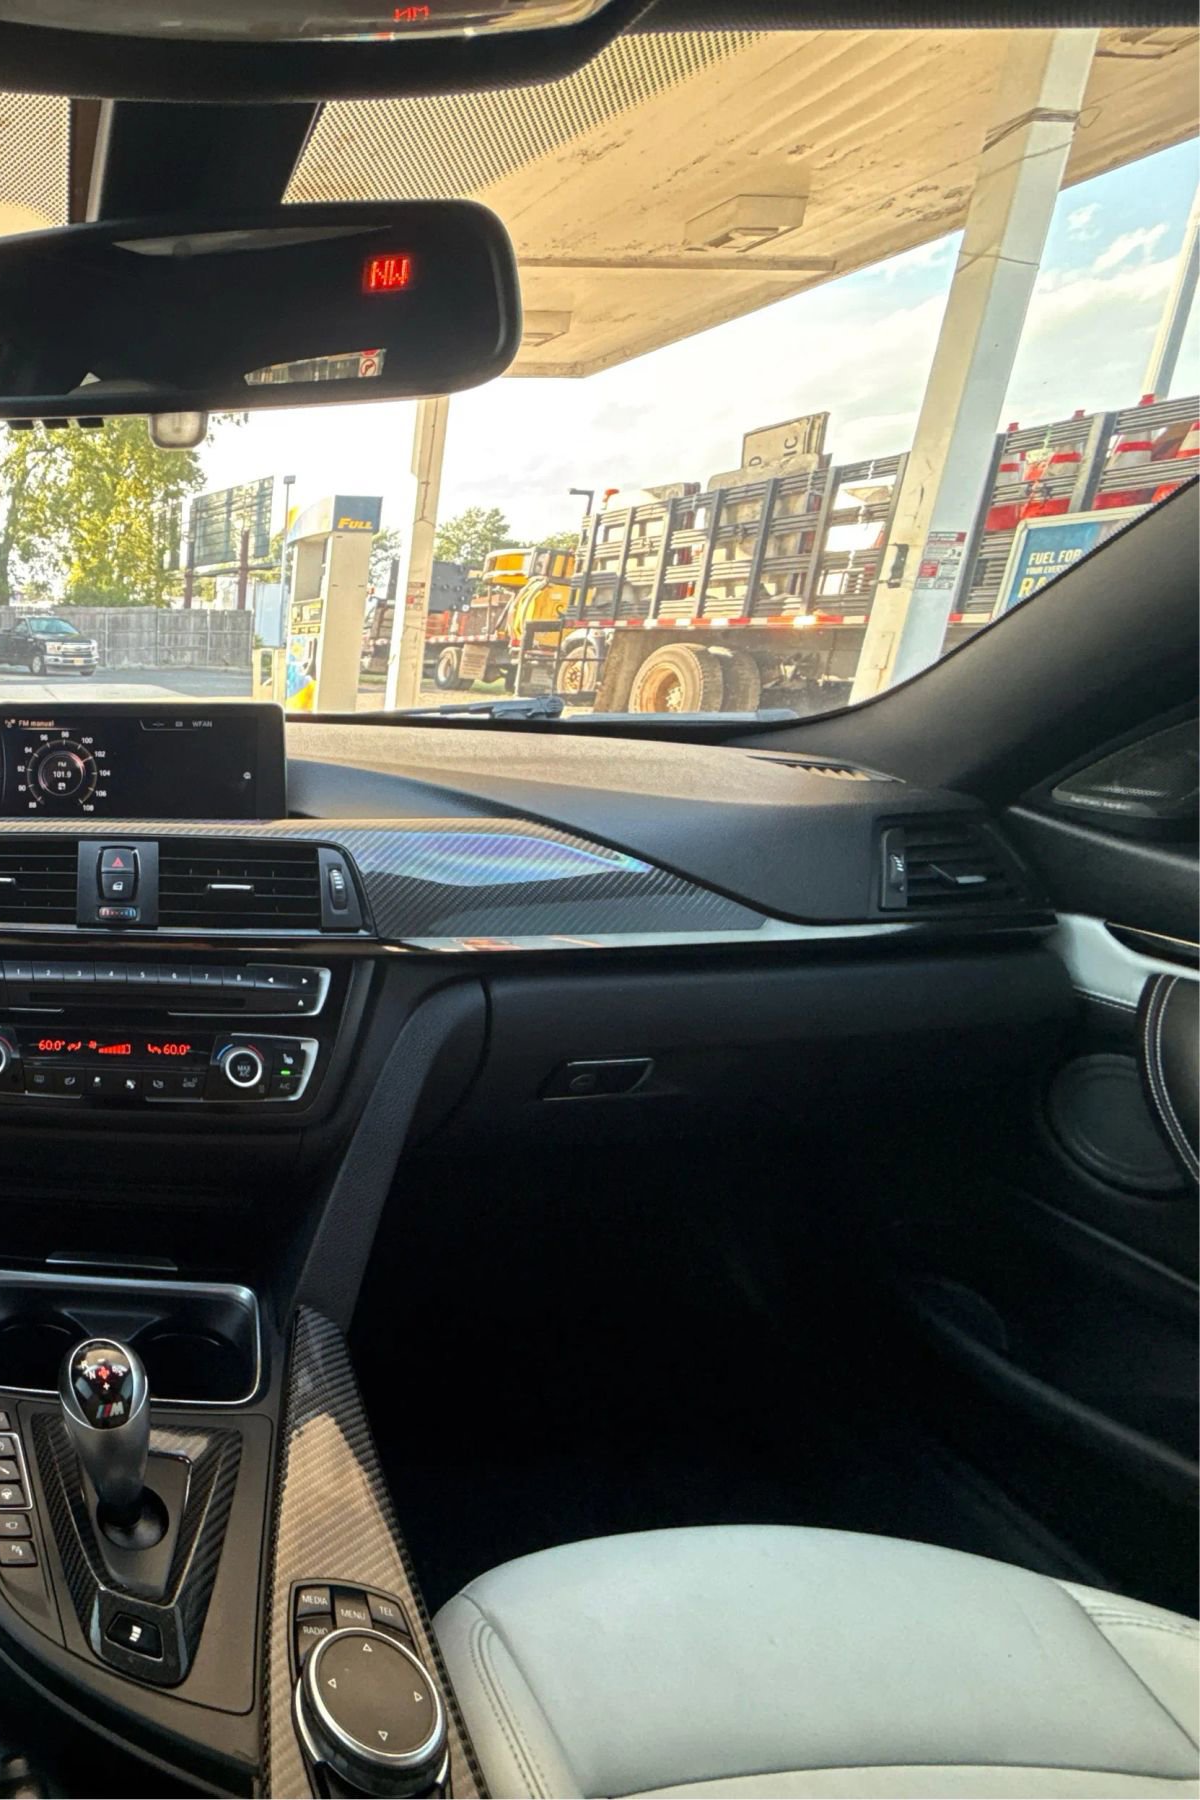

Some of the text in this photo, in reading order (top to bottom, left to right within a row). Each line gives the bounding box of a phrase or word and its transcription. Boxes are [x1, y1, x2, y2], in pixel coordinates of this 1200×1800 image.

[370, 259, 409, 287] NW
[1028, 552, 1055, 565] FUEL
[302, 1594, 328, 1605] MEDIA
[340, 1608, 366, 1620] MENU
[379, 1606, 393, 1617] TEL
[303, 1626, 328, 1635] RADIO
